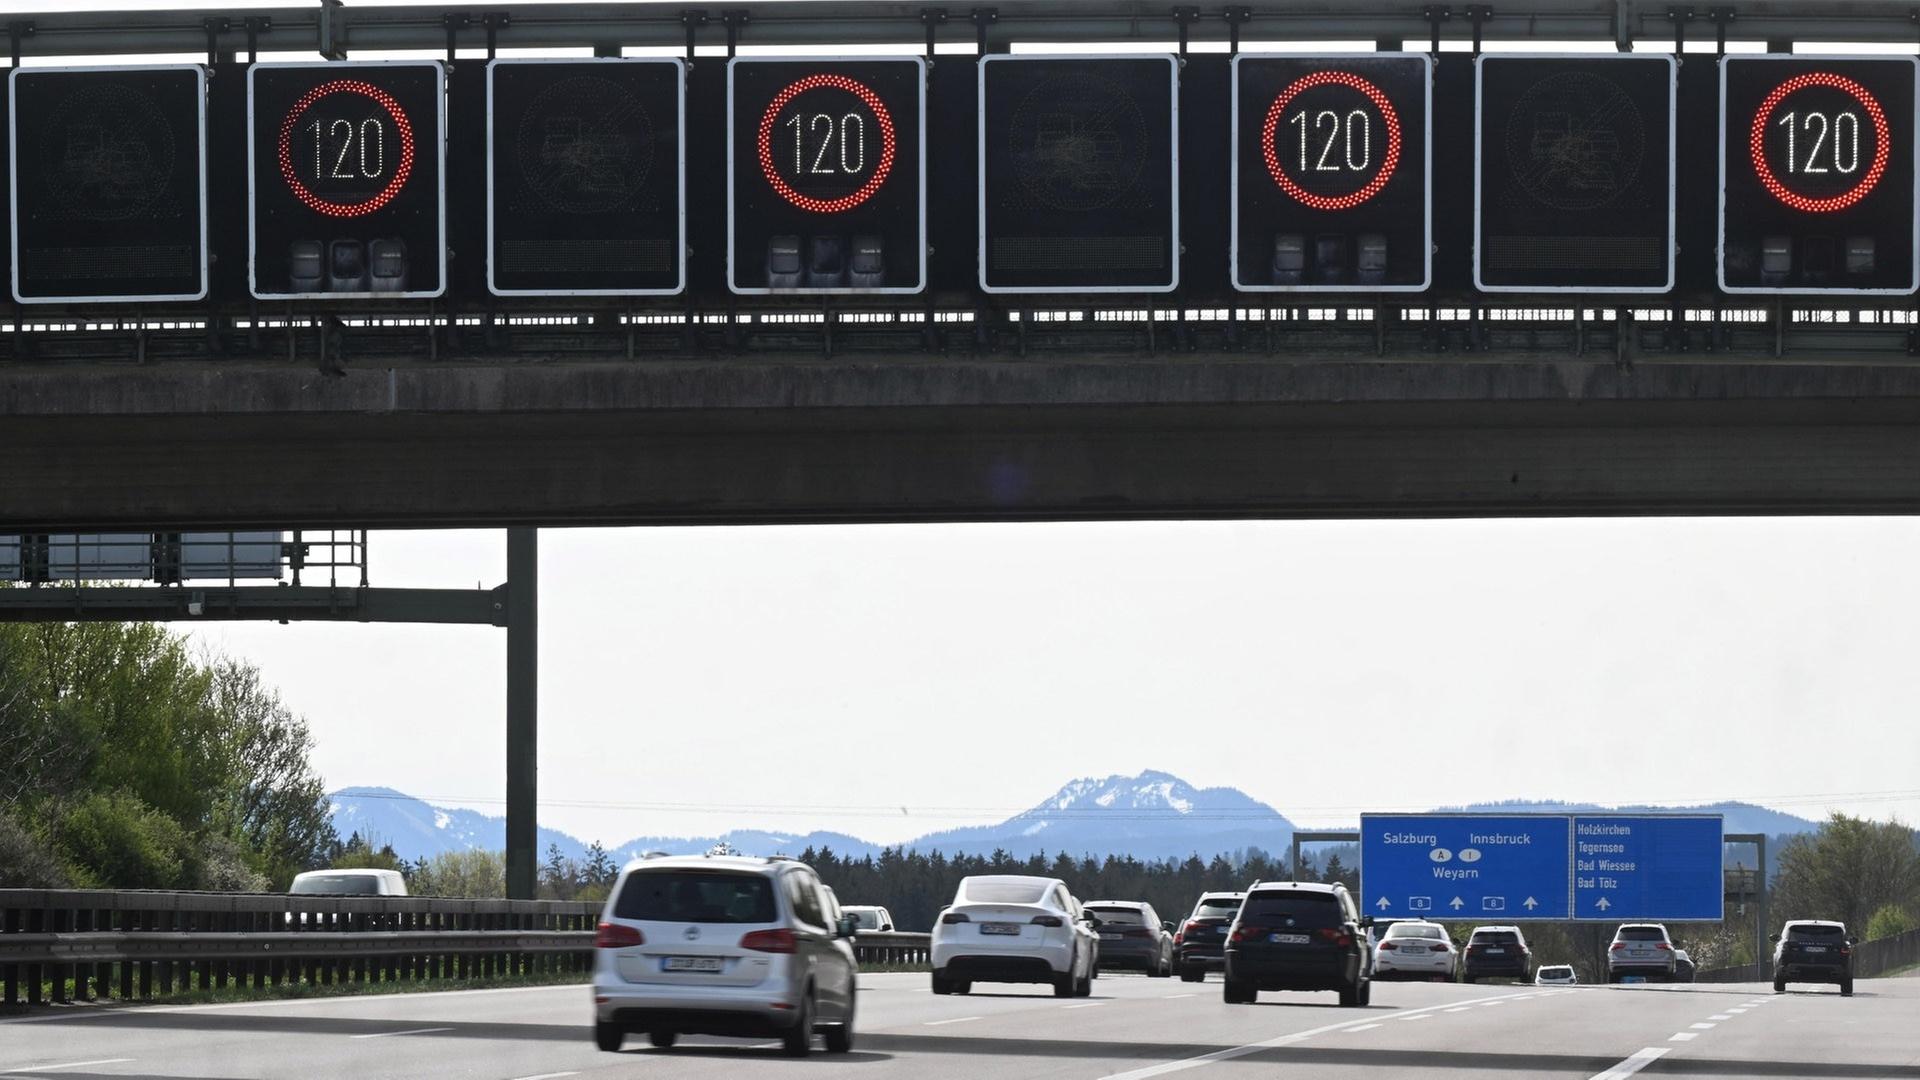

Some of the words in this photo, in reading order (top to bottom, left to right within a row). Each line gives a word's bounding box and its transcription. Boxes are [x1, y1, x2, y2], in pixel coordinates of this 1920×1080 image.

[786, 113, 865, 174] 120
[1291, 110, 1369, 171] 120
[1778, 111, 1859, 173] 120
[306, 118, 383, 179] 120
[1577, 823, 1631, 835] Holzkirchen
[1383, 832, 1437, 846] Salzburg
[1470, 833, 1531, 845] Innsbruck
[1578, 841, 1624, 855] Tegernsee
[1437, 851, 1445, 860] A
[1577, 860, 1595, 871] Bad
[1598, 860, 1636, 871] Wiessee
[1433, 867, 1479, 881] Weyarn
[1577, 877, 1595, 888] Bad
[1599, 877, 1617, 888] Tölz
